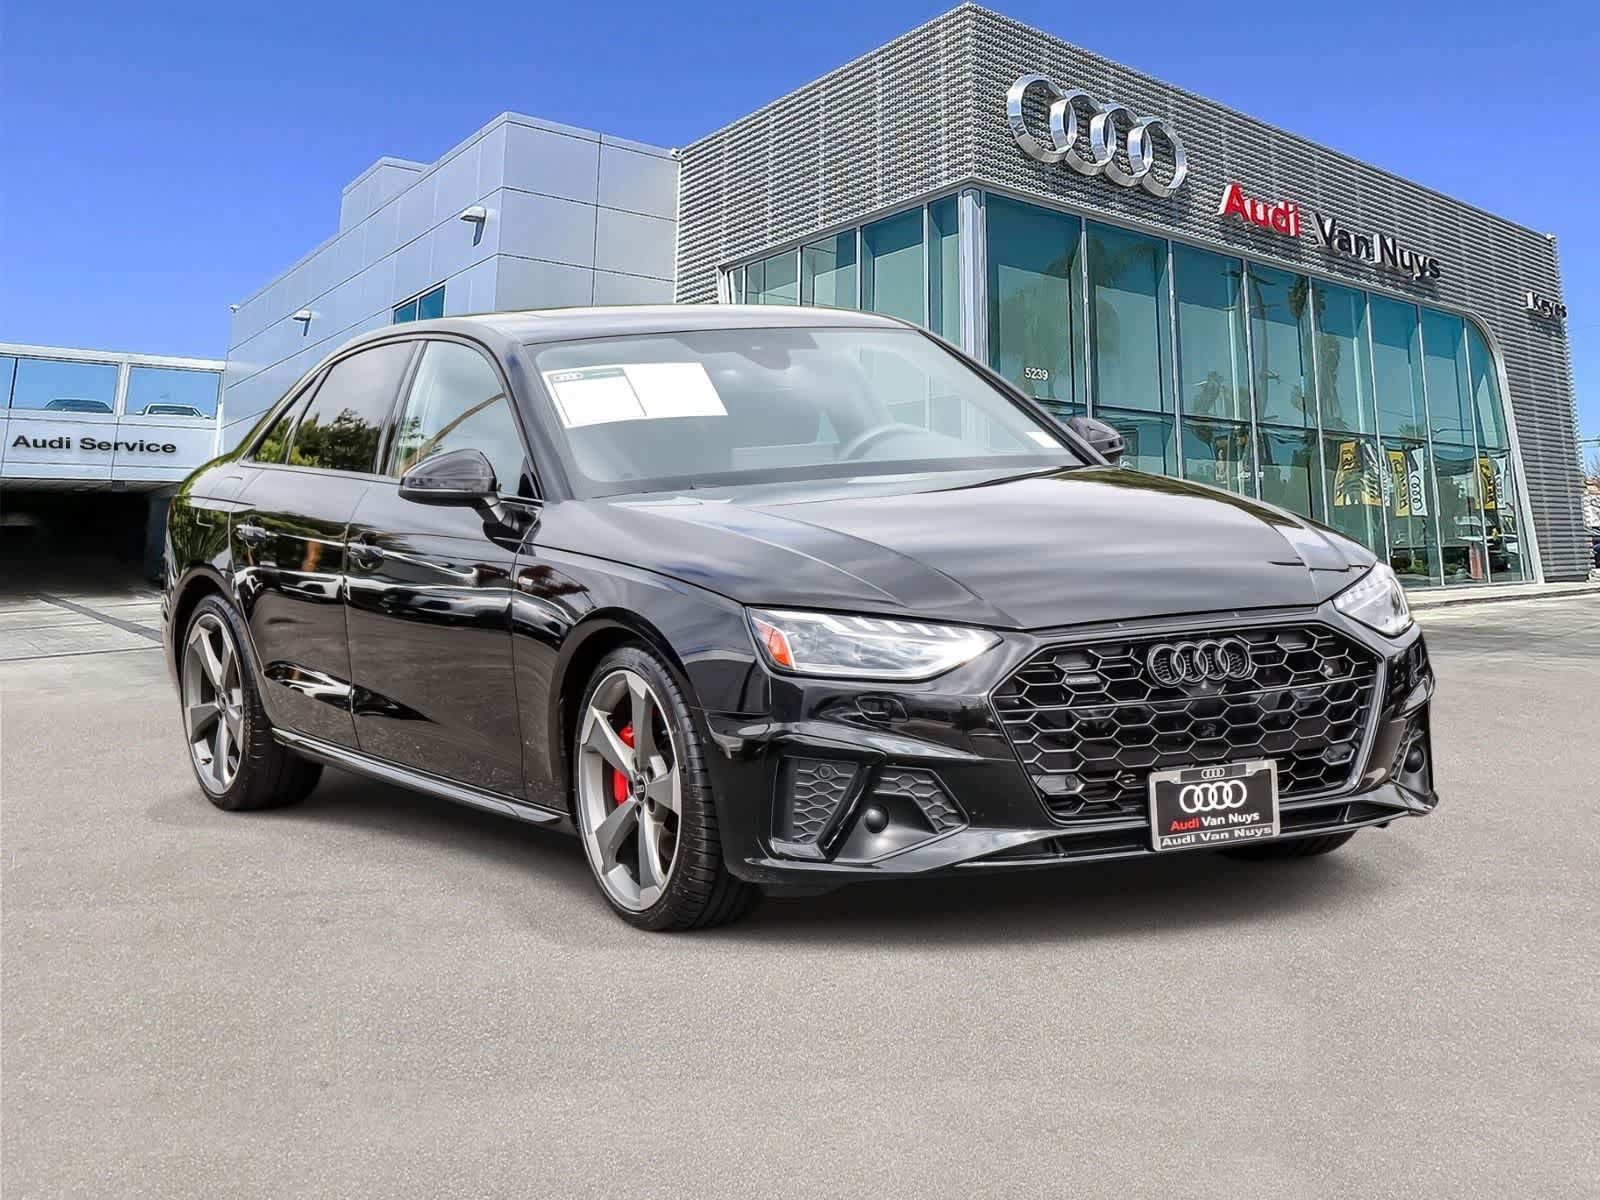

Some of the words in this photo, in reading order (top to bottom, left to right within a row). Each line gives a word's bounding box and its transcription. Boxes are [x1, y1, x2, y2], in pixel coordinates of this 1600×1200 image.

[1219, 183, 1301, 237] Audi
[1310, 212, 1371, 259] Van
[1373, 233, 1441, 281] Nuys
[1526, 291, 1568, 319] Keyes
[1025, 367, 1049, 381] 5239
[12, 435, 71, 450] Audi
[79, 437, 177, 454] Service
[1170, 818, 1200, 831] Audi
[1201, 815, 1226, 827] Van
[1228, 812, 1260, 825] Nuys
[1162, 834, 1196, 847] Audi
[1200, 832, 1229, 841] Van
[1234, 826, 1272, 838] Nuys
